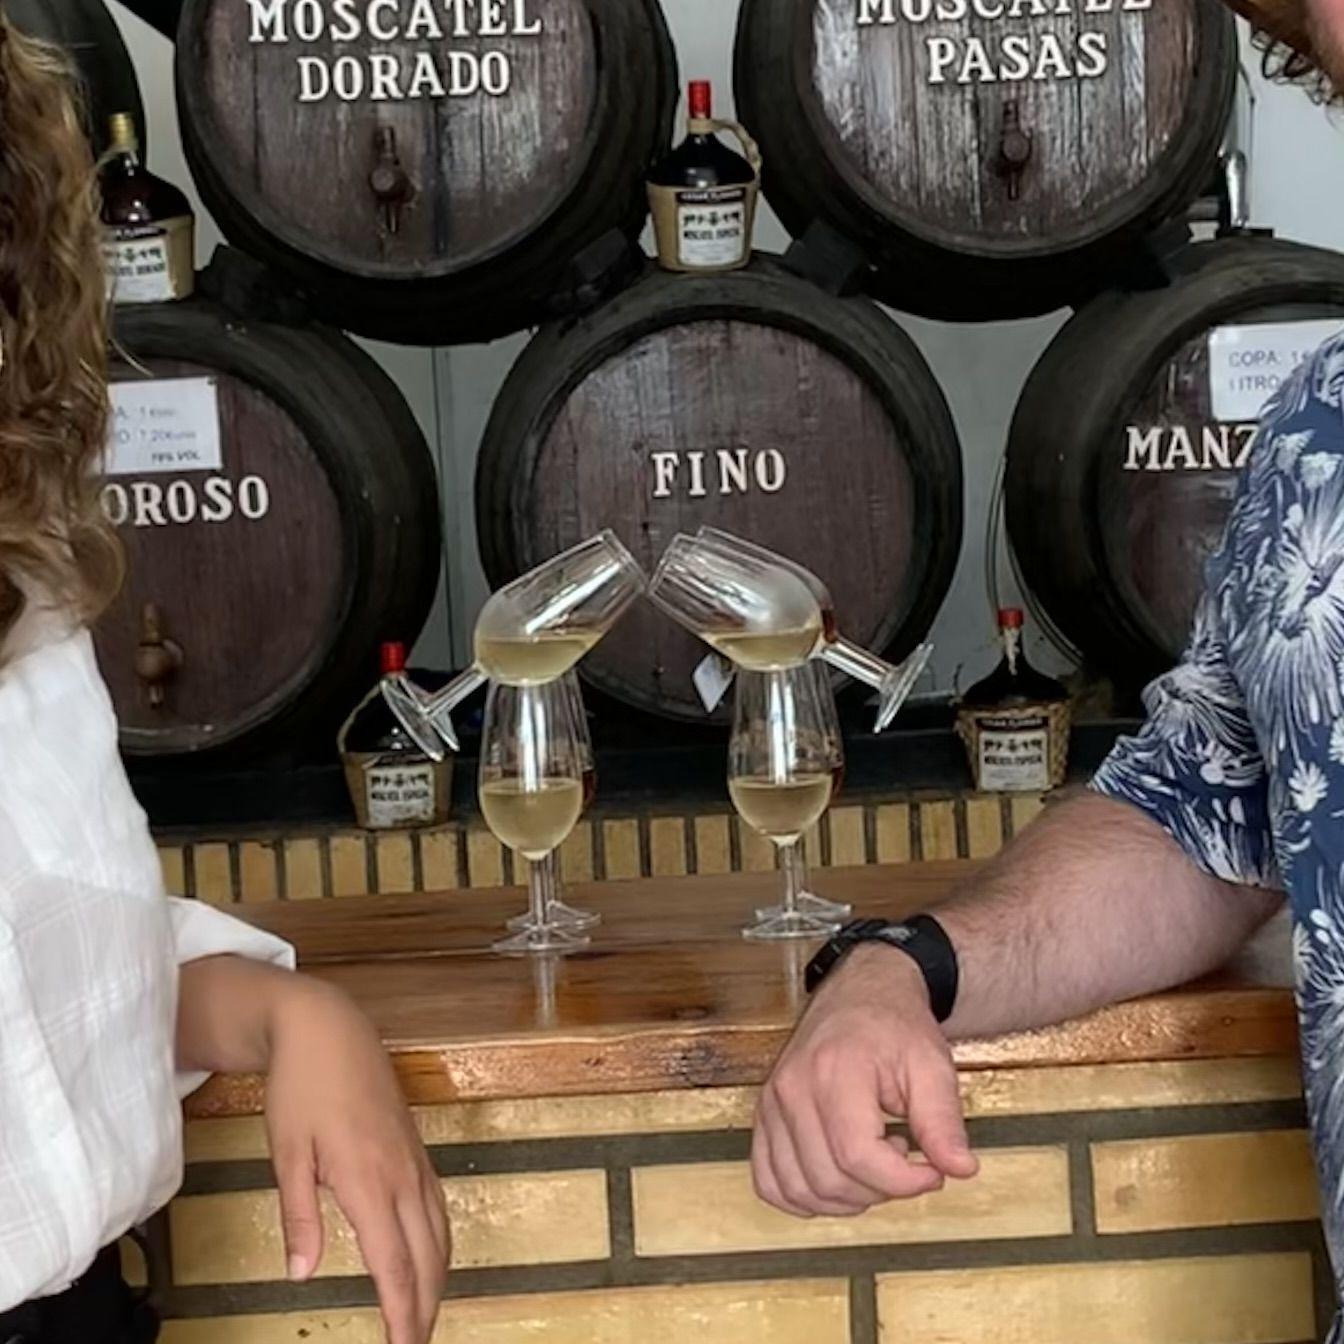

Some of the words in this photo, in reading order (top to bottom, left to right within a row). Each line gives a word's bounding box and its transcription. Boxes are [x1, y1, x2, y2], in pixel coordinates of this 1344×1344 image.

[297, 50, 510, 102] DORADO
[926, 32, 1107, 84] PASAS
[650, 448, 786, 497] FINO
[1123, 425, 1258, 472] MANZ
[100, 475, 270, 527] OROSO
